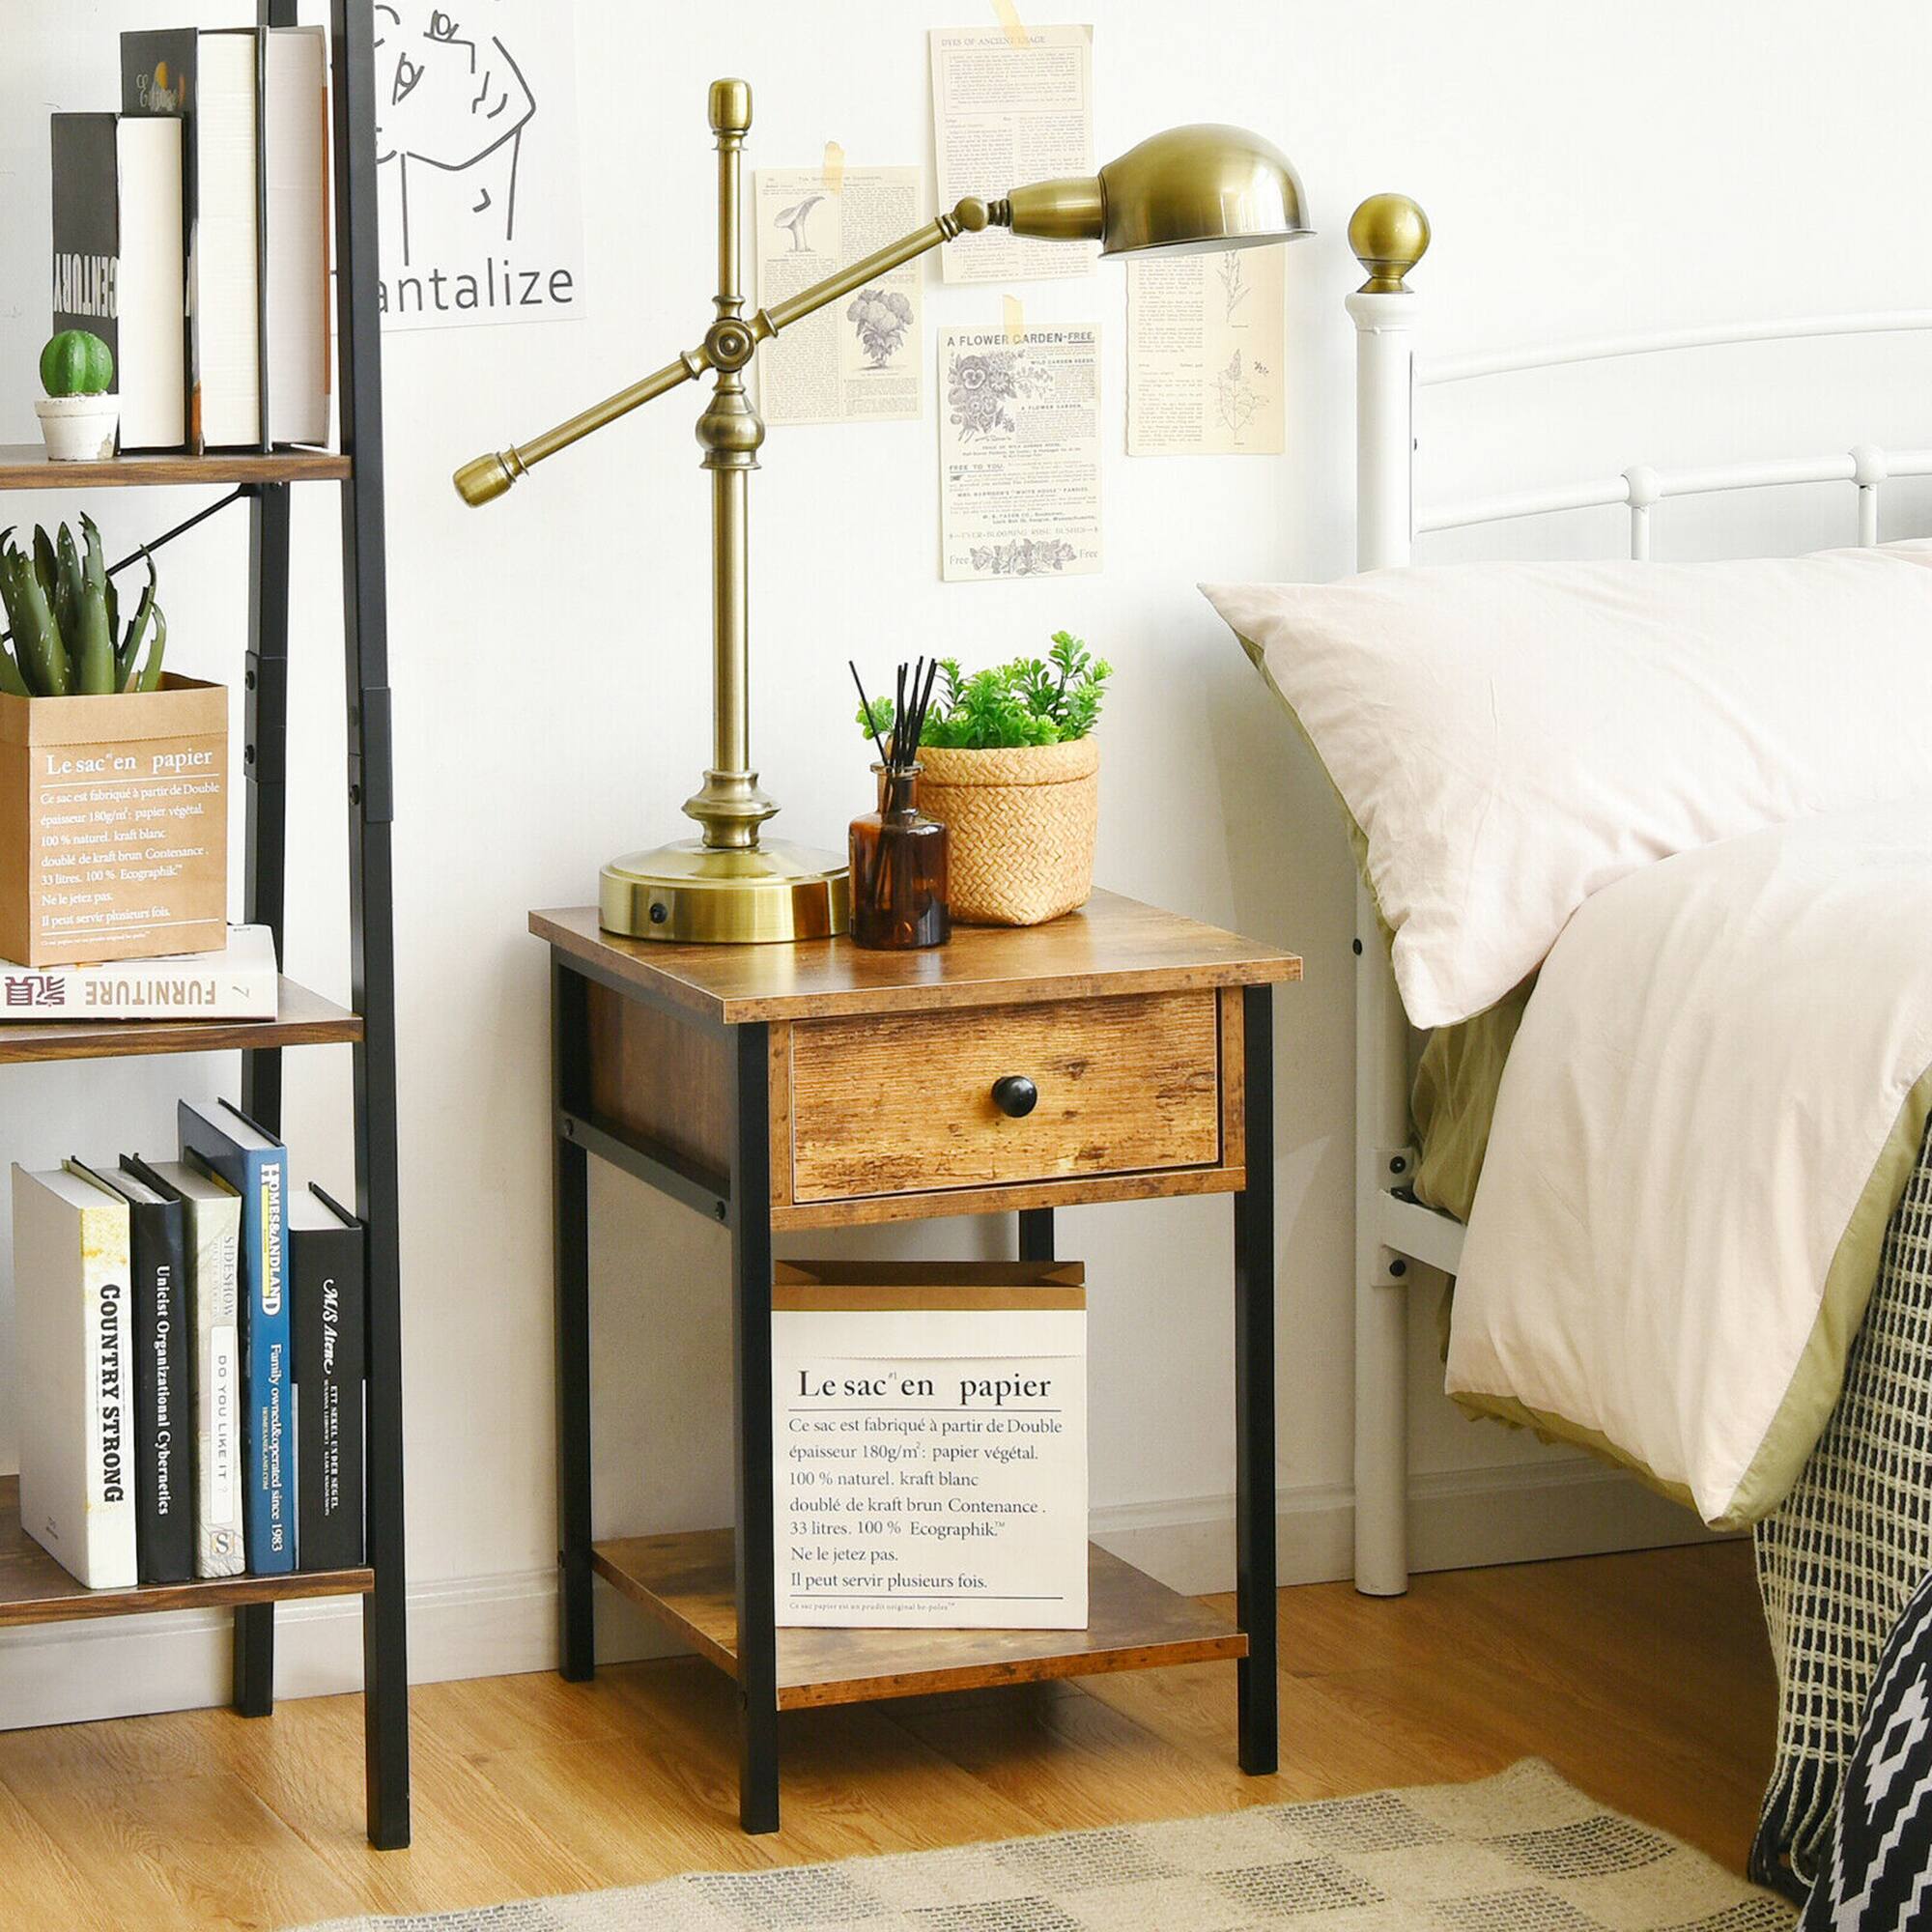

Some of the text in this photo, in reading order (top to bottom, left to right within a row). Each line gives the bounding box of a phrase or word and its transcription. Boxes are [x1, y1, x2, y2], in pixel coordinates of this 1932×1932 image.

[54, 253, 118, 319] CENTURY
[947, 337, 954, 346] A
[960, 335, 1009, 346] FLOWER
[950, 555, 969, 564] Free
[1080, 549, 1098, 558] Free
[47, 754, 72, 775] Le
[114, 756, 135, 770] en
[153, 749, 213, 774] papier
[56, 793, 71, 803] sac
[141, 786, 169, 799] partir
[170, 783, 182, 794] de
[184, 782, 219, 794] Double
[135, 808, 165, 821] papier
[42, 836, 58, 846] 100
[114, 830, 137, 841] kraft
[139, 829, 164, 839] blanc
[42, 855, 77, 867] doublé
[79, 852, 91, 864] de
[93, 850, 116, 863] kraft
[118, 849, 141, 861] brun
[42, 874, 53, 885] 33
[86, 870, 103, 881] 100
[42, 894, 57, 906] Ne
[59, 892, 68, 904] le
[5, 976, 65, 1007] 家具
[86, 980, 215, 1005] FURNITURE
[223, 1236, 234, 1316] SIDESHOW
[218, 1356, 226, 1377] DO
[99, 1283, 124, 1503] COUNTRY STRONG
[154, 1264, 170, 1516] Unicist Organizational Cybernetics
[799, 1370, 836, 1397] Le
[901, 1377, 934, 1396] en
[960, 1373, 1051, 1406] papier
[789, 1418, 810, 1433] Ce
[840, 1420, 859, 1431] est
[864, 1418, 924, 1436] fabriqué
[929, 1418, 937, 1432] à
[942, 1420, 983, 1436] partir
[986, 1419, 1004, 1433] de
[1008, 1418, 1063, 1434] Double
[218, 1423, 227, 1460] LIKE
[270, 1344, 284, 1551] Family owned&operated since 1983
[789, 1447, 857, 1463] épaisseur
[933, 1447, 979, 1463] papier
[984, 1446, 1038, 1463] végétal.
[218, 1463, 226, 1479] IT
[789, 1471, 978, 1487] 100 % naturel. kraft blanc
[330, 1479, 341, 1508] SEGEL
[789, 1497, 840, 1512] doublé
[846, 1498, 864, 1512] de
[867, 1497, 902, 1512] kraft
[907, 1498, 943, 1512] brun
[789, 1522, 808, 1535] 33
[811, 1521, 852, 1534] litres.
[858, 1521, 883, 1534] 100
[887, 1522, 901, 1534] %
[216, 1534, 228, 1553] S
[791, 1548, 898, 1565] Ne le jetez pas.
[791, 1574, 987, 1591] Il peut servir plusieurs fois.
